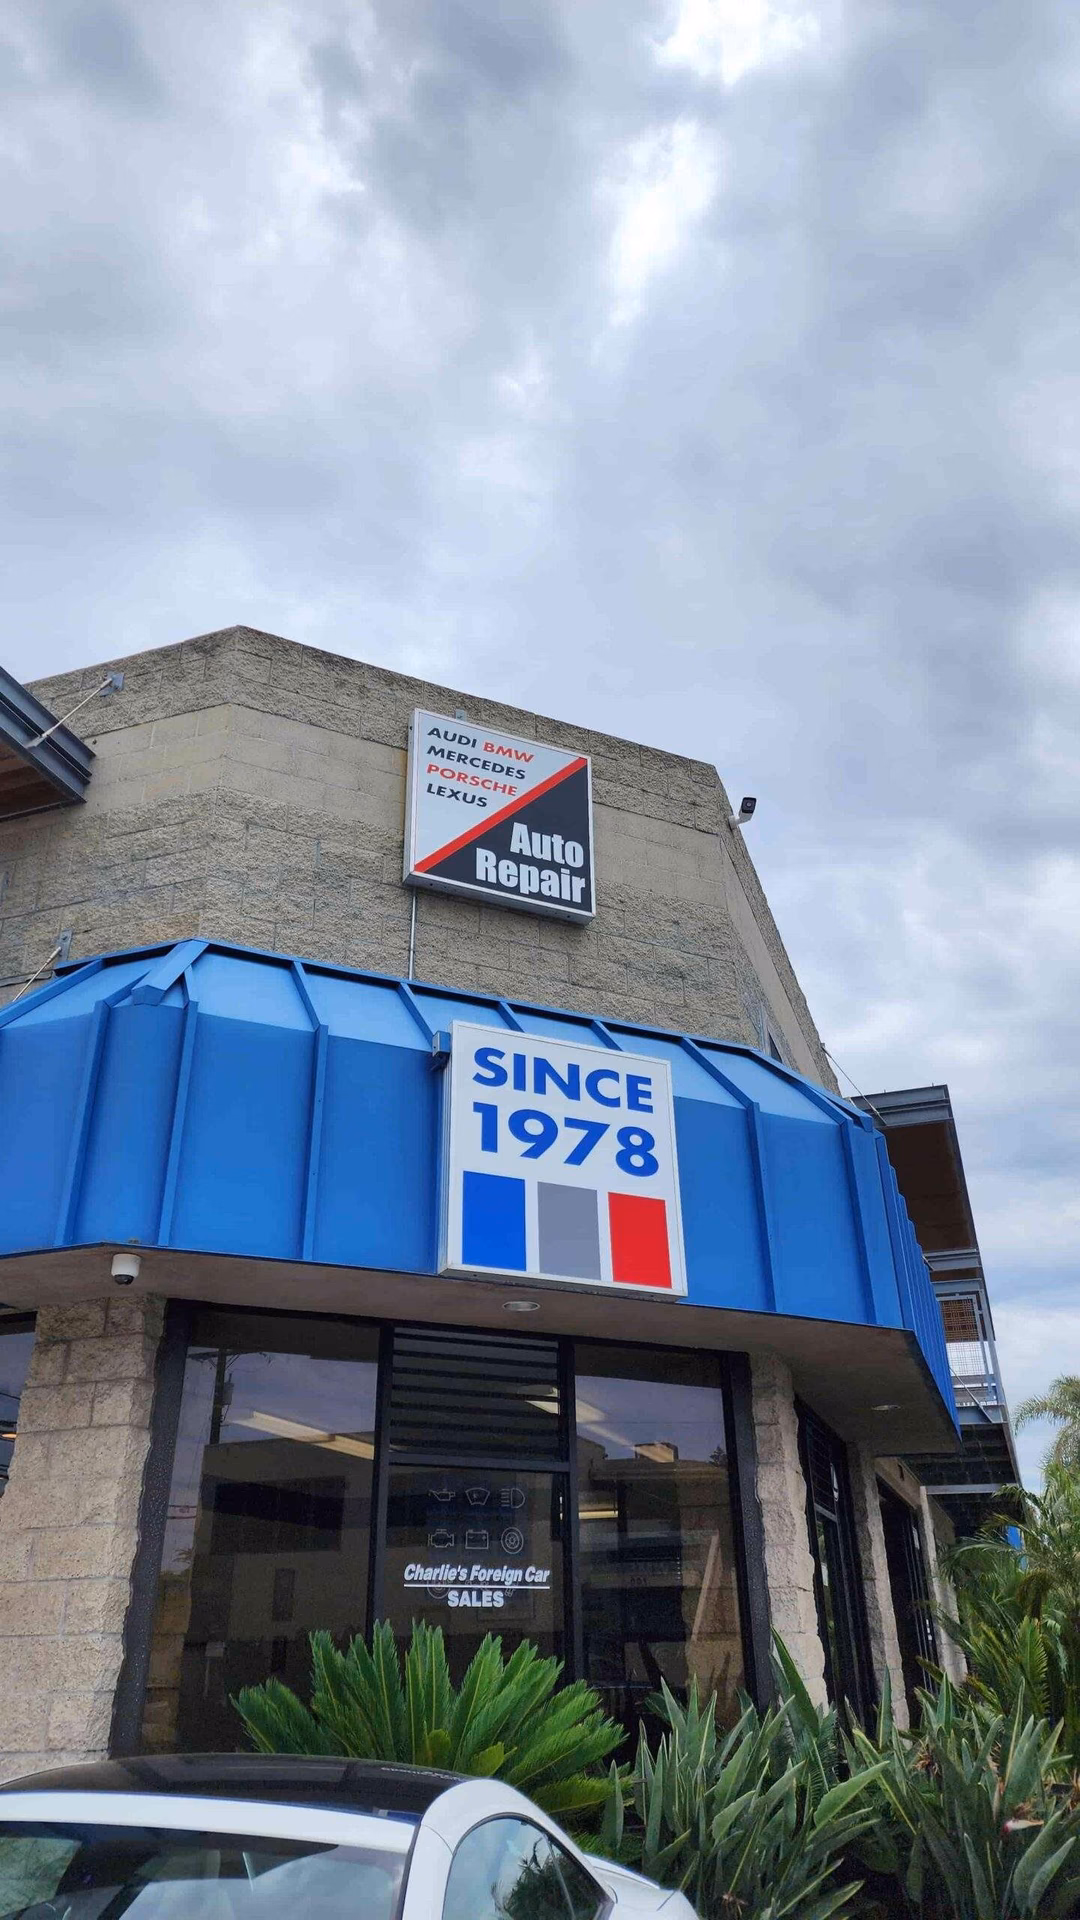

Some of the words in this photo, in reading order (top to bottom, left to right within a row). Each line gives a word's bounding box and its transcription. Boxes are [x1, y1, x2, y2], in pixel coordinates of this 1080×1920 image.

[427, 727, 478, 748] AUDI
[482, 741, 535, 763] BMW
[427, 745, 526, 780] MERCEDES
[426, 763, 518, 796] PORSCHE
[426, 783, 488, 808] LEXUS
[510, 822, 584, 868] Auto
[475, 847, 586, 903] Repair
[472, 1047, 653, 1113] SINCE
[473, 1102, 659, 1177] 1978
[404, 1564, 467, 1581] Charlie's
[470, 1565, 523, 1585] Foreign
[525, 1566, 550, 1583] Car
[447, 1590, 505, 1608] SALES
